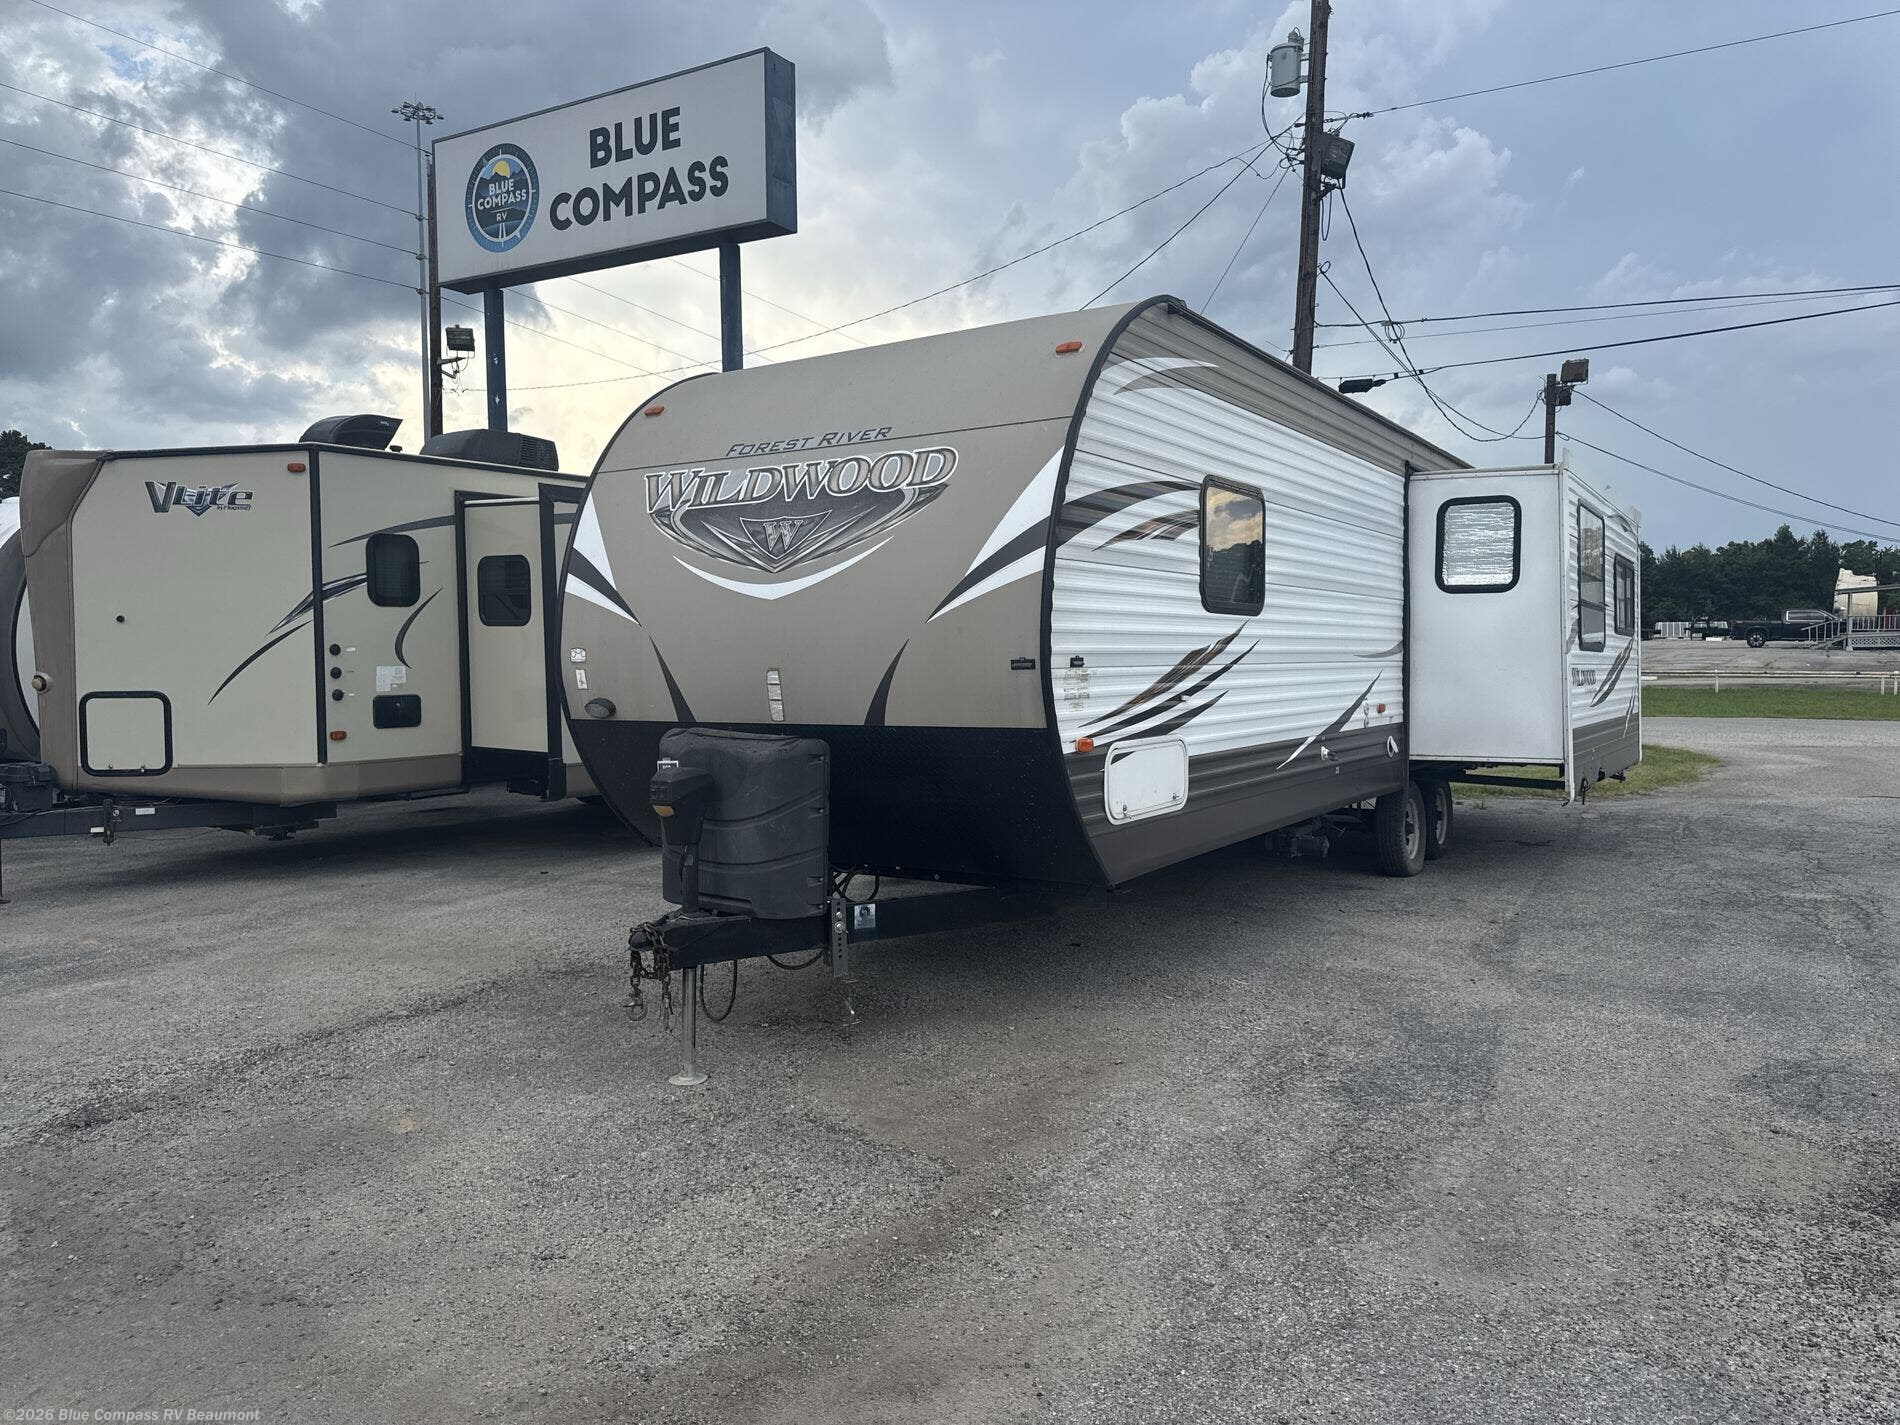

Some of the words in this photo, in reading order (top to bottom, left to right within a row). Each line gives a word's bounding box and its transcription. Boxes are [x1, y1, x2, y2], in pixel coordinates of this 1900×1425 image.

[589, 106, 681, 169] BLUE
[477, 189, 527, 210] COMPASS
[488, 179, 514, 196] BLUE
[549, 155, 729, 231] COMPASS
[496, 212, 508, 222] RV
[645, 446, 958, 513] WILDWOOD
[762, 519, 803, 551] W
